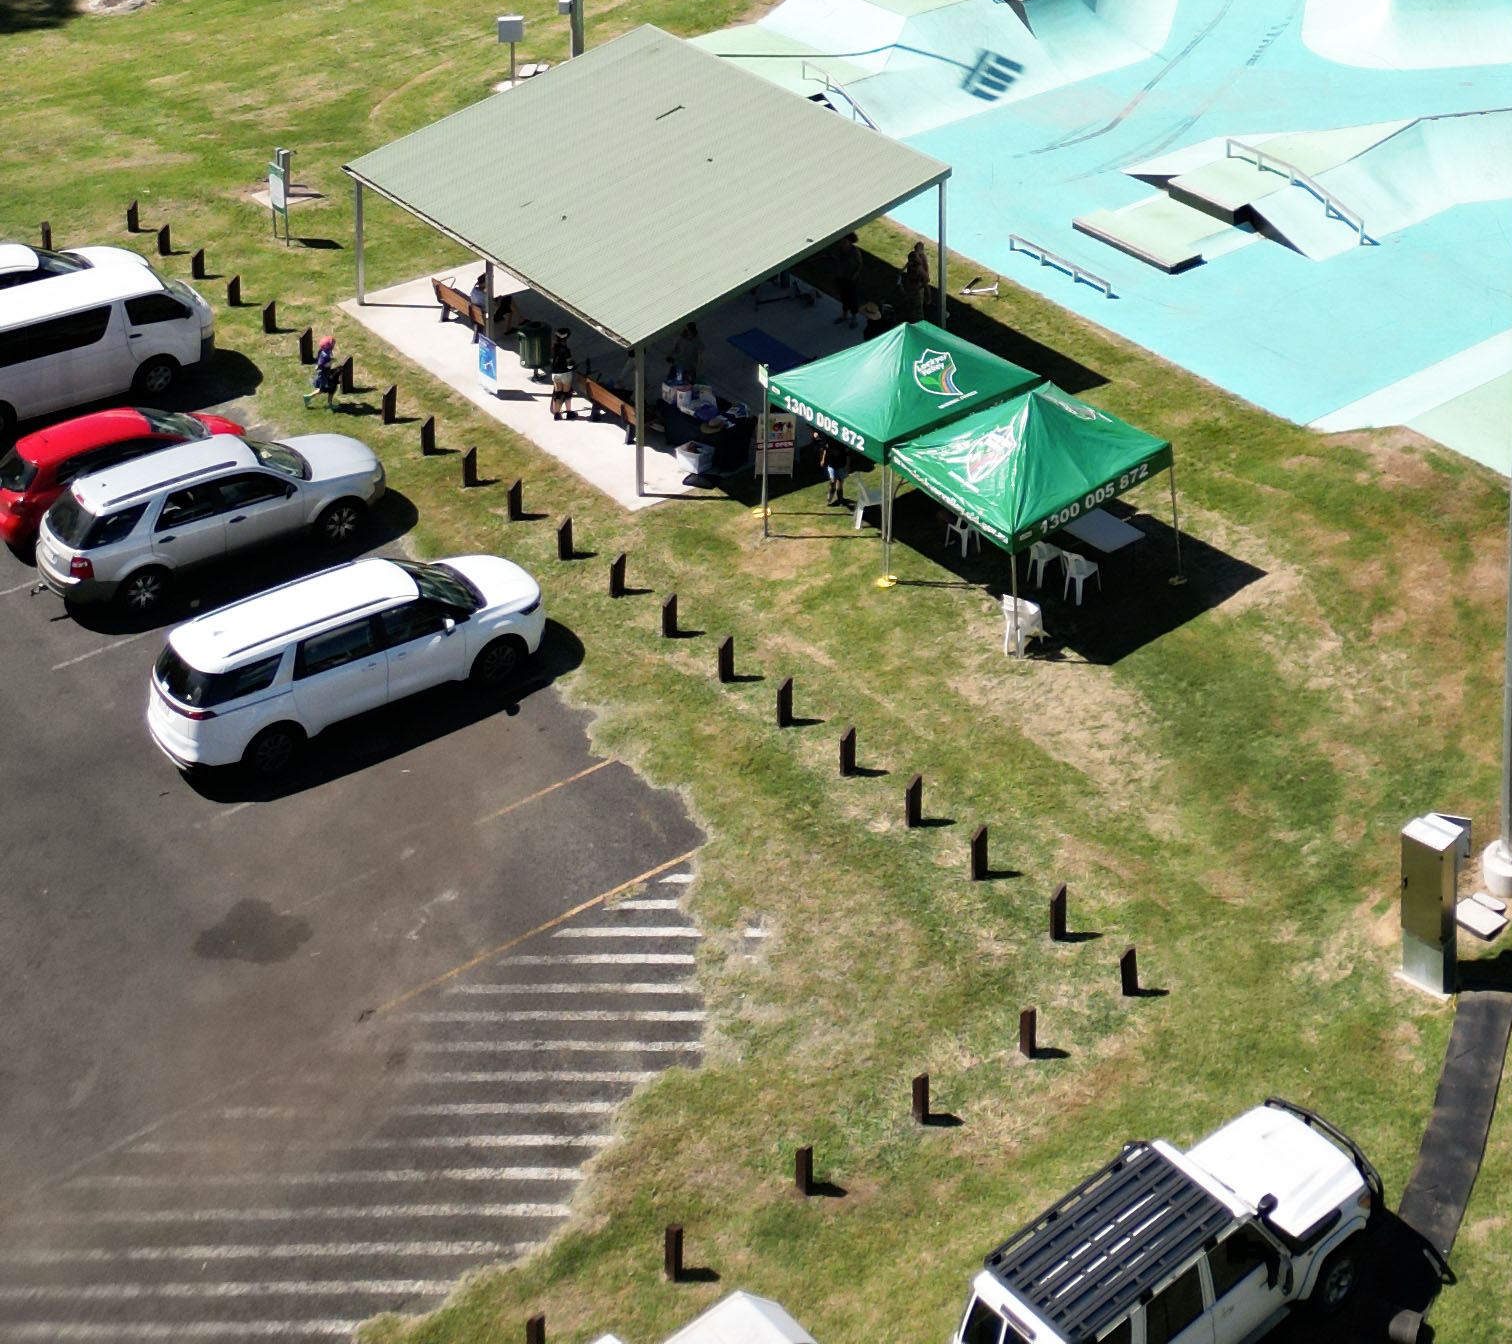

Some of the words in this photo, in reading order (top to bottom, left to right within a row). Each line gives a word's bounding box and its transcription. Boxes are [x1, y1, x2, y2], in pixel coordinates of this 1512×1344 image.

[784, 395, 814, 421] 1300
[816, 412, 839, 436] 005
[841, 426, 865, 452] 872
[1040, 503, 1080, 534] 1300
[1085, 482, 1115, 509] 005
[1119, 463, 1149, 490] 872
